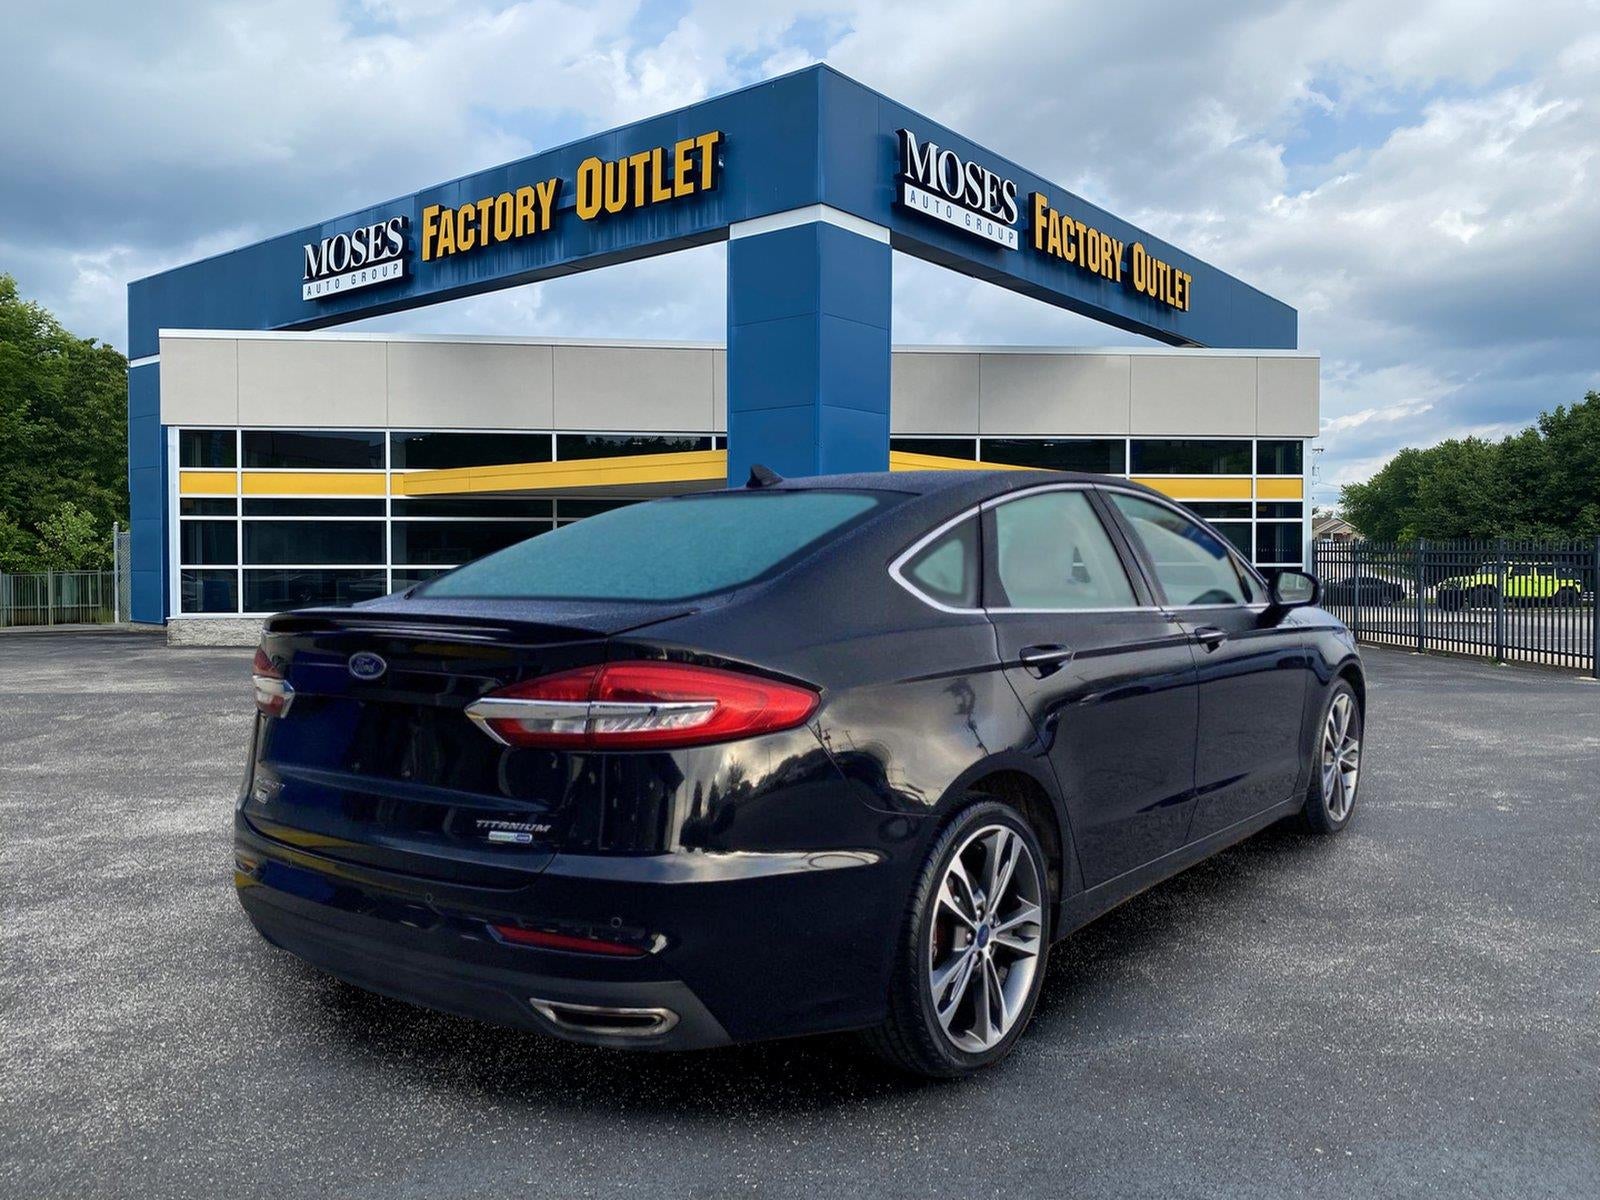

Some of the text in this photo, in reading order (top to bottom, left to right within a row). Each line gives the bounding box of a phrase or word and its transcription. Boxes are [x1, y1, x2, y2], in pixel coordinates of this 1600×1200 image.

[421, 130, 720, 261] FACTORY OUTLET
[904, 128, 1018, 224] MOSES
[303, 216, 403, 280] MOSES
[910, 190, 1014, 244] AUTO GROUP
[307, 263, 399, 296] AUTO GROUP
[1034, 192, 1192, 311] FACTORY OUTLET
[476, 820, 551, 832] TITANIUM
